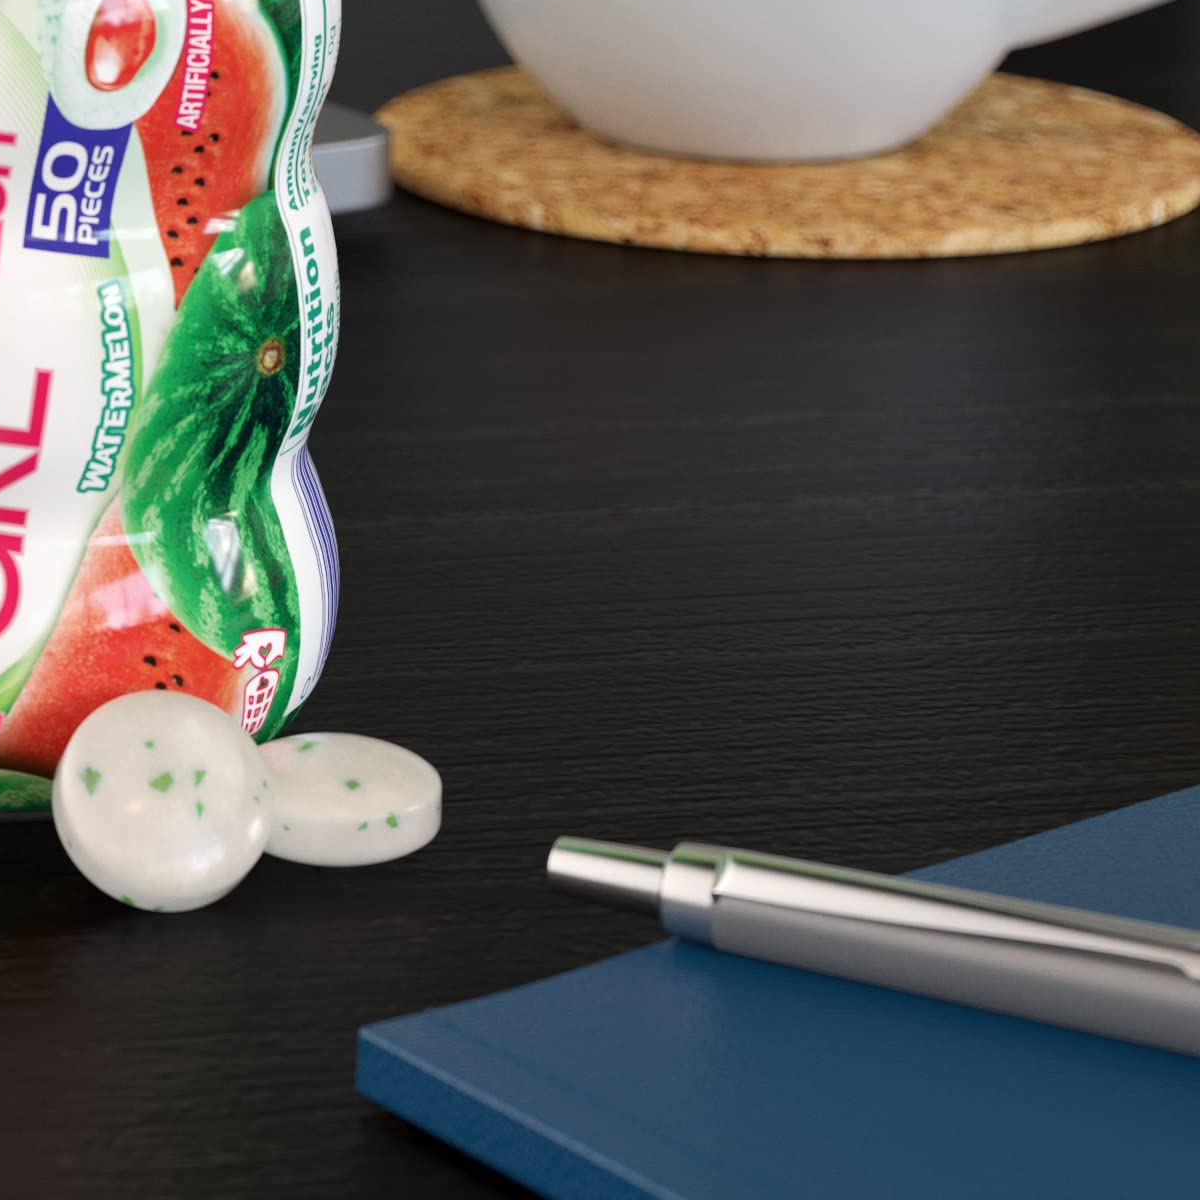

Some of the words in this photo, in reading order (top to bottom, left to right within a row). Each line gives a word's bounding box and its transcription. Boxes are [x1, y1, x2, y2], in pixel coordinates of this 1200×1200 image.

[31, 140, 89, 244] 50
[76, 145, 115, 246] PIECES
[80, 282, 133, 490] WATERMELON
[289, 226, 323, 439] Nutrition
